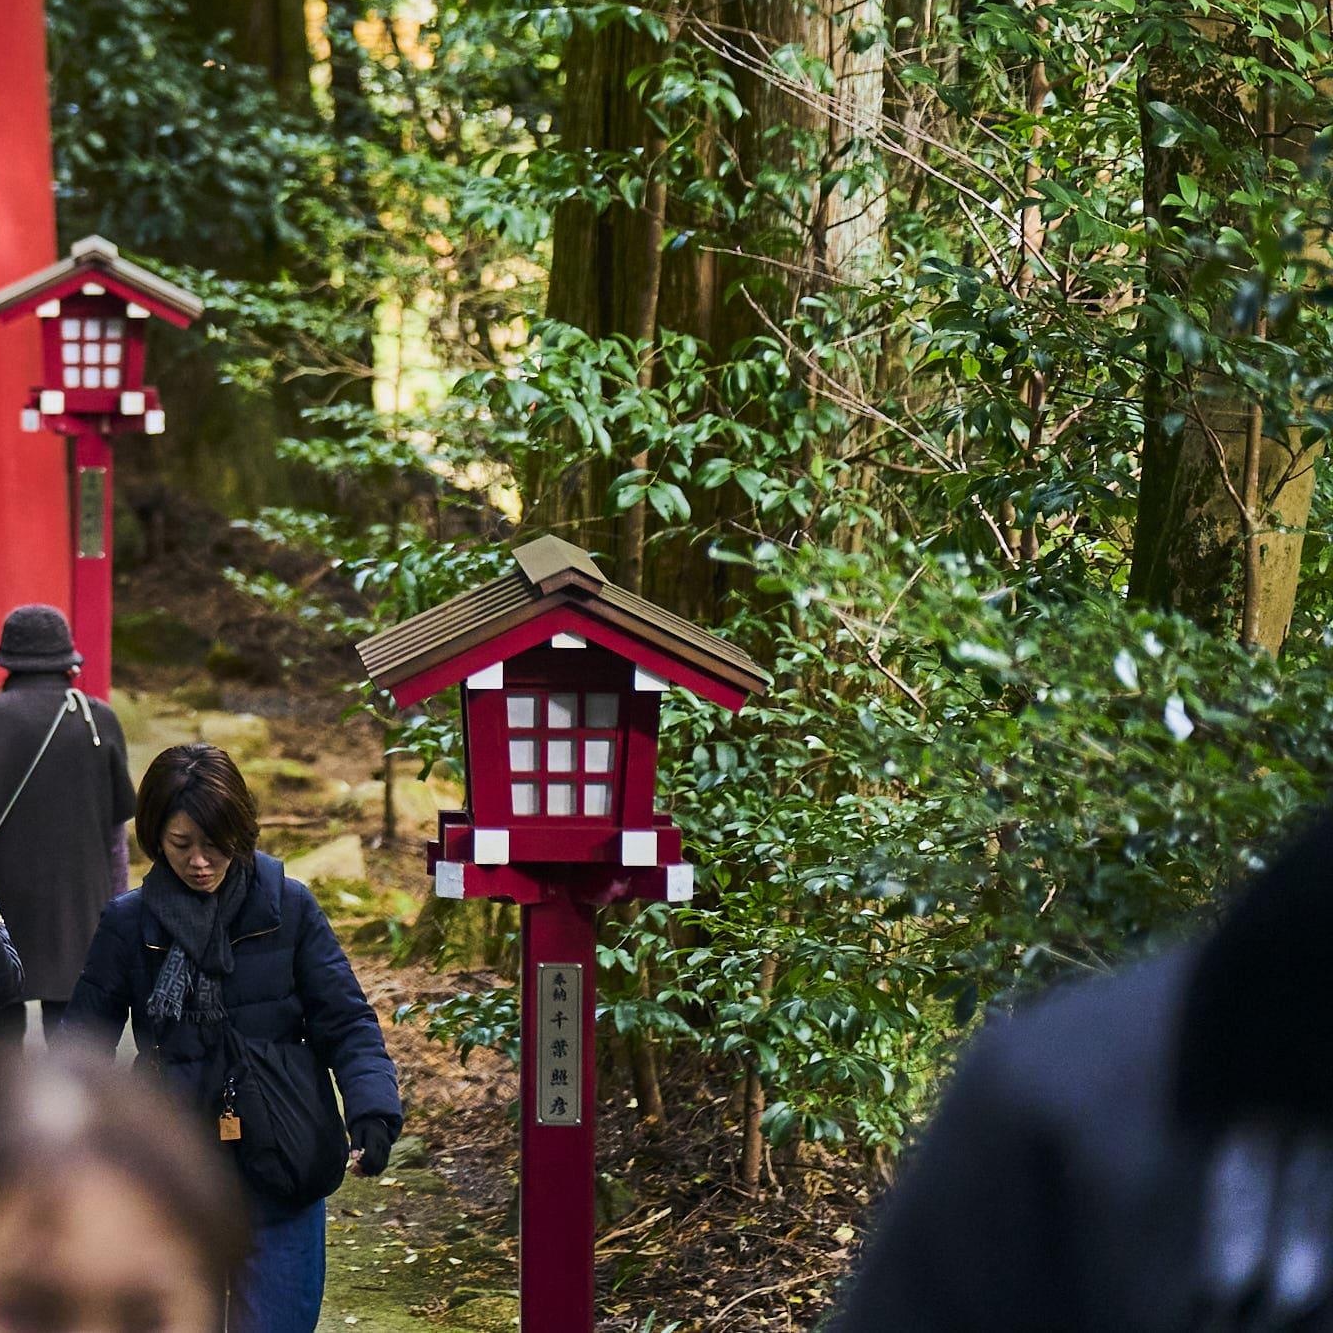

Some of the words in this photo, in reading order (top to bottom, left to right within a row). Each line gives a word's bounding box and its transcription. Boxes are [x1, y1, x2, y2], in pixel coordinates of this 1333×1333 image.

[553, 972, 567, 1001] 奉納
[550, 1010, 568, 1116] 千葉照彦
